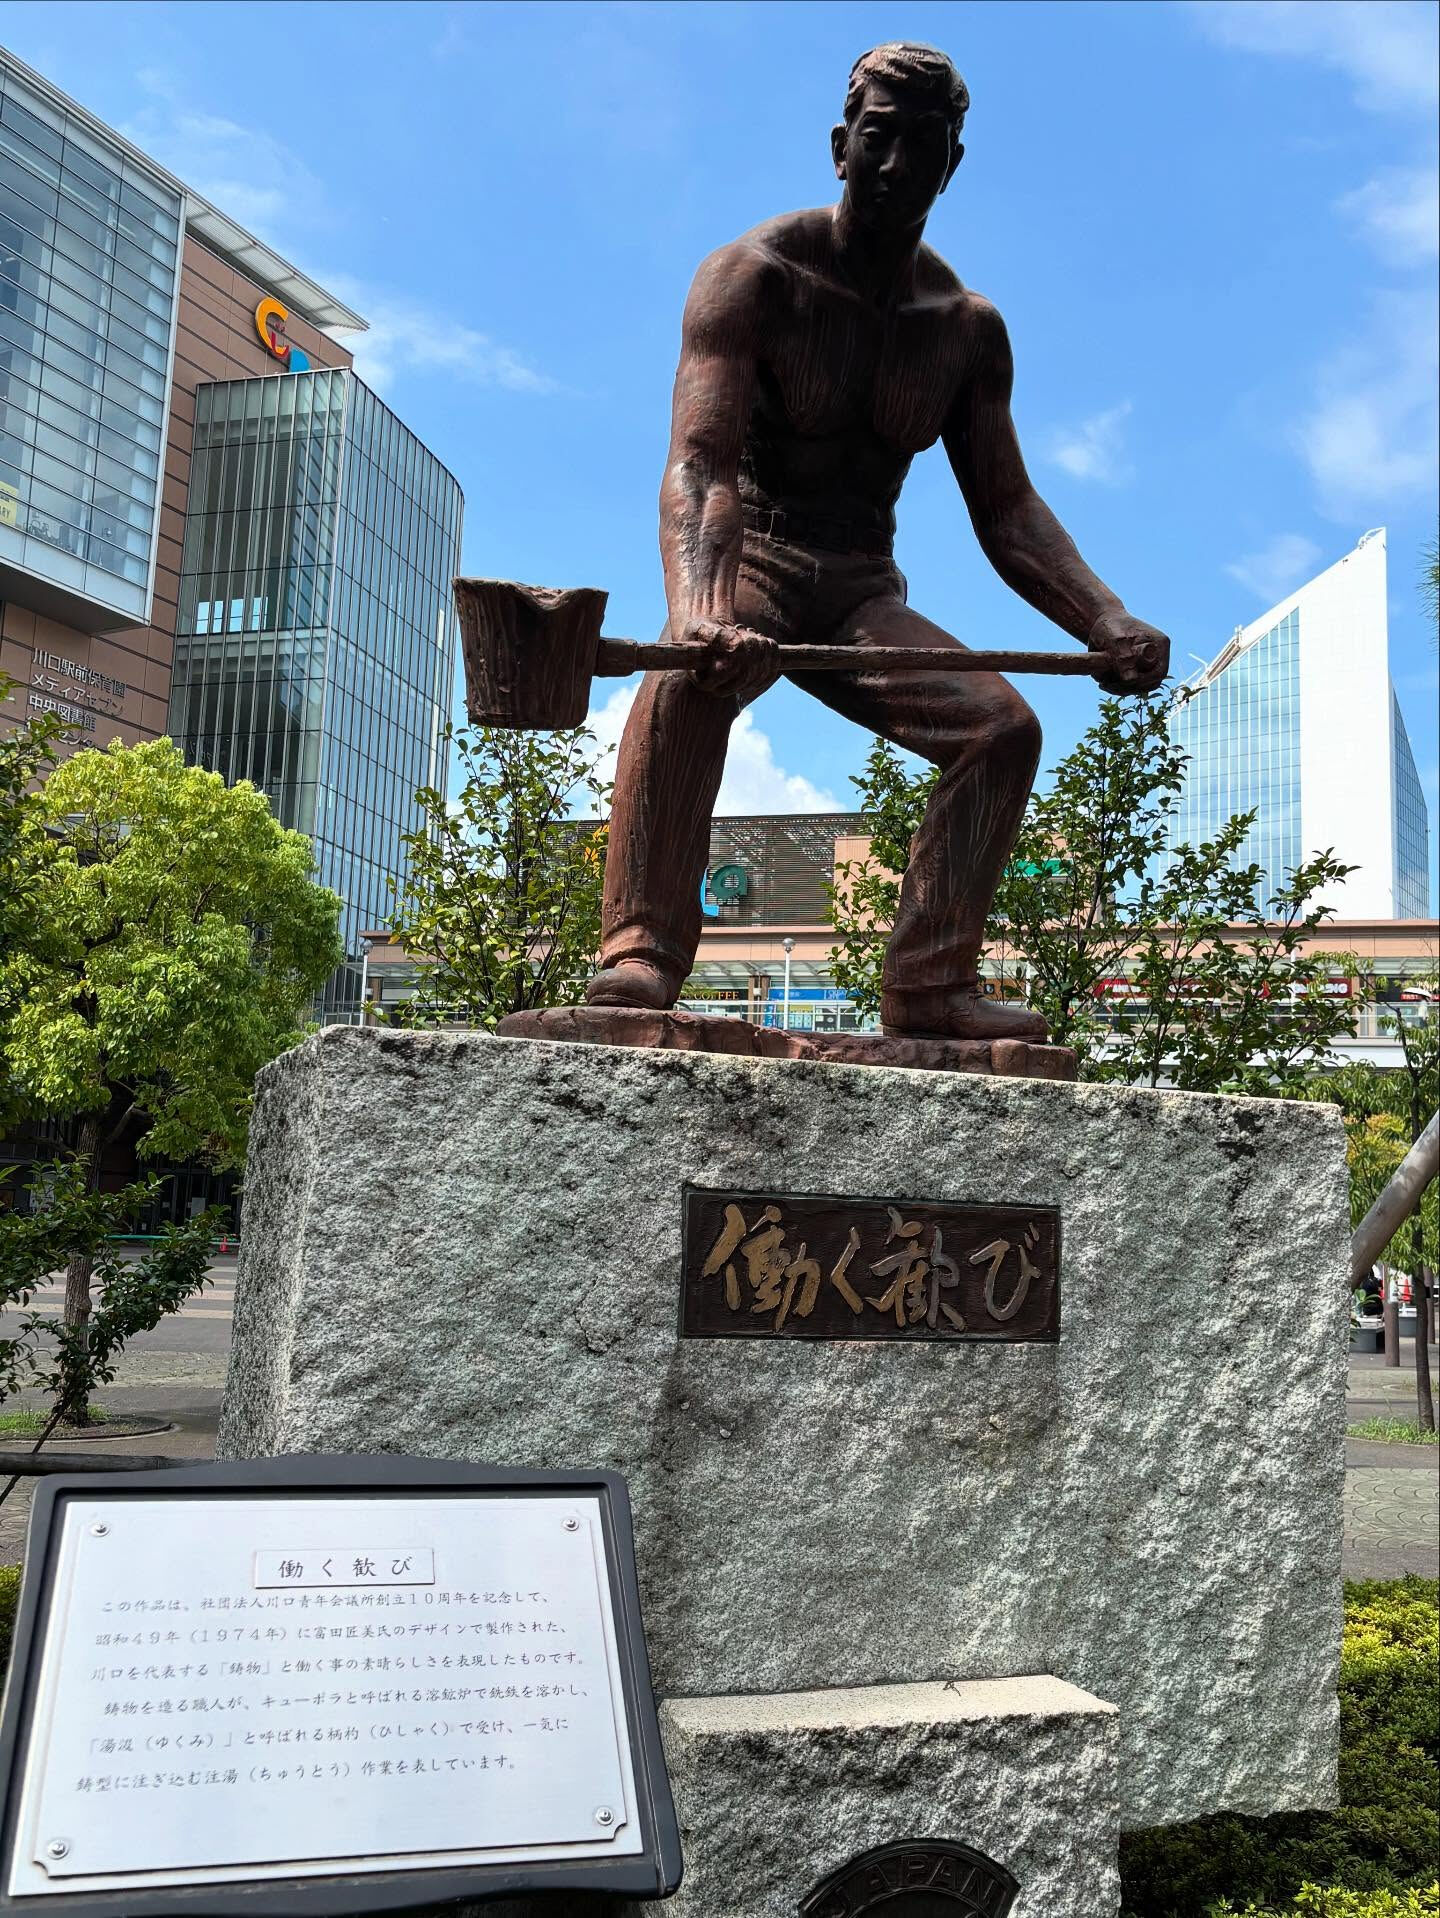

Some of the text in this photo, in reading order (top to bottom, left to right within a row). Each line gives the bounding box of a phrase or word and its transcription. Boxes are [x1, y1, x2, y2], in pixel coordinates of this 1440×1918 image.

[33, 647, 126, 698] 川口駅前保育園
[29, 694, 96, 732] 中央図書館
[32, 674, 124, 715] メディアセブン
[702, 1203, 1041, 1332] 働く歓び
[277, 1556, 412, 1579] 働く歓び
